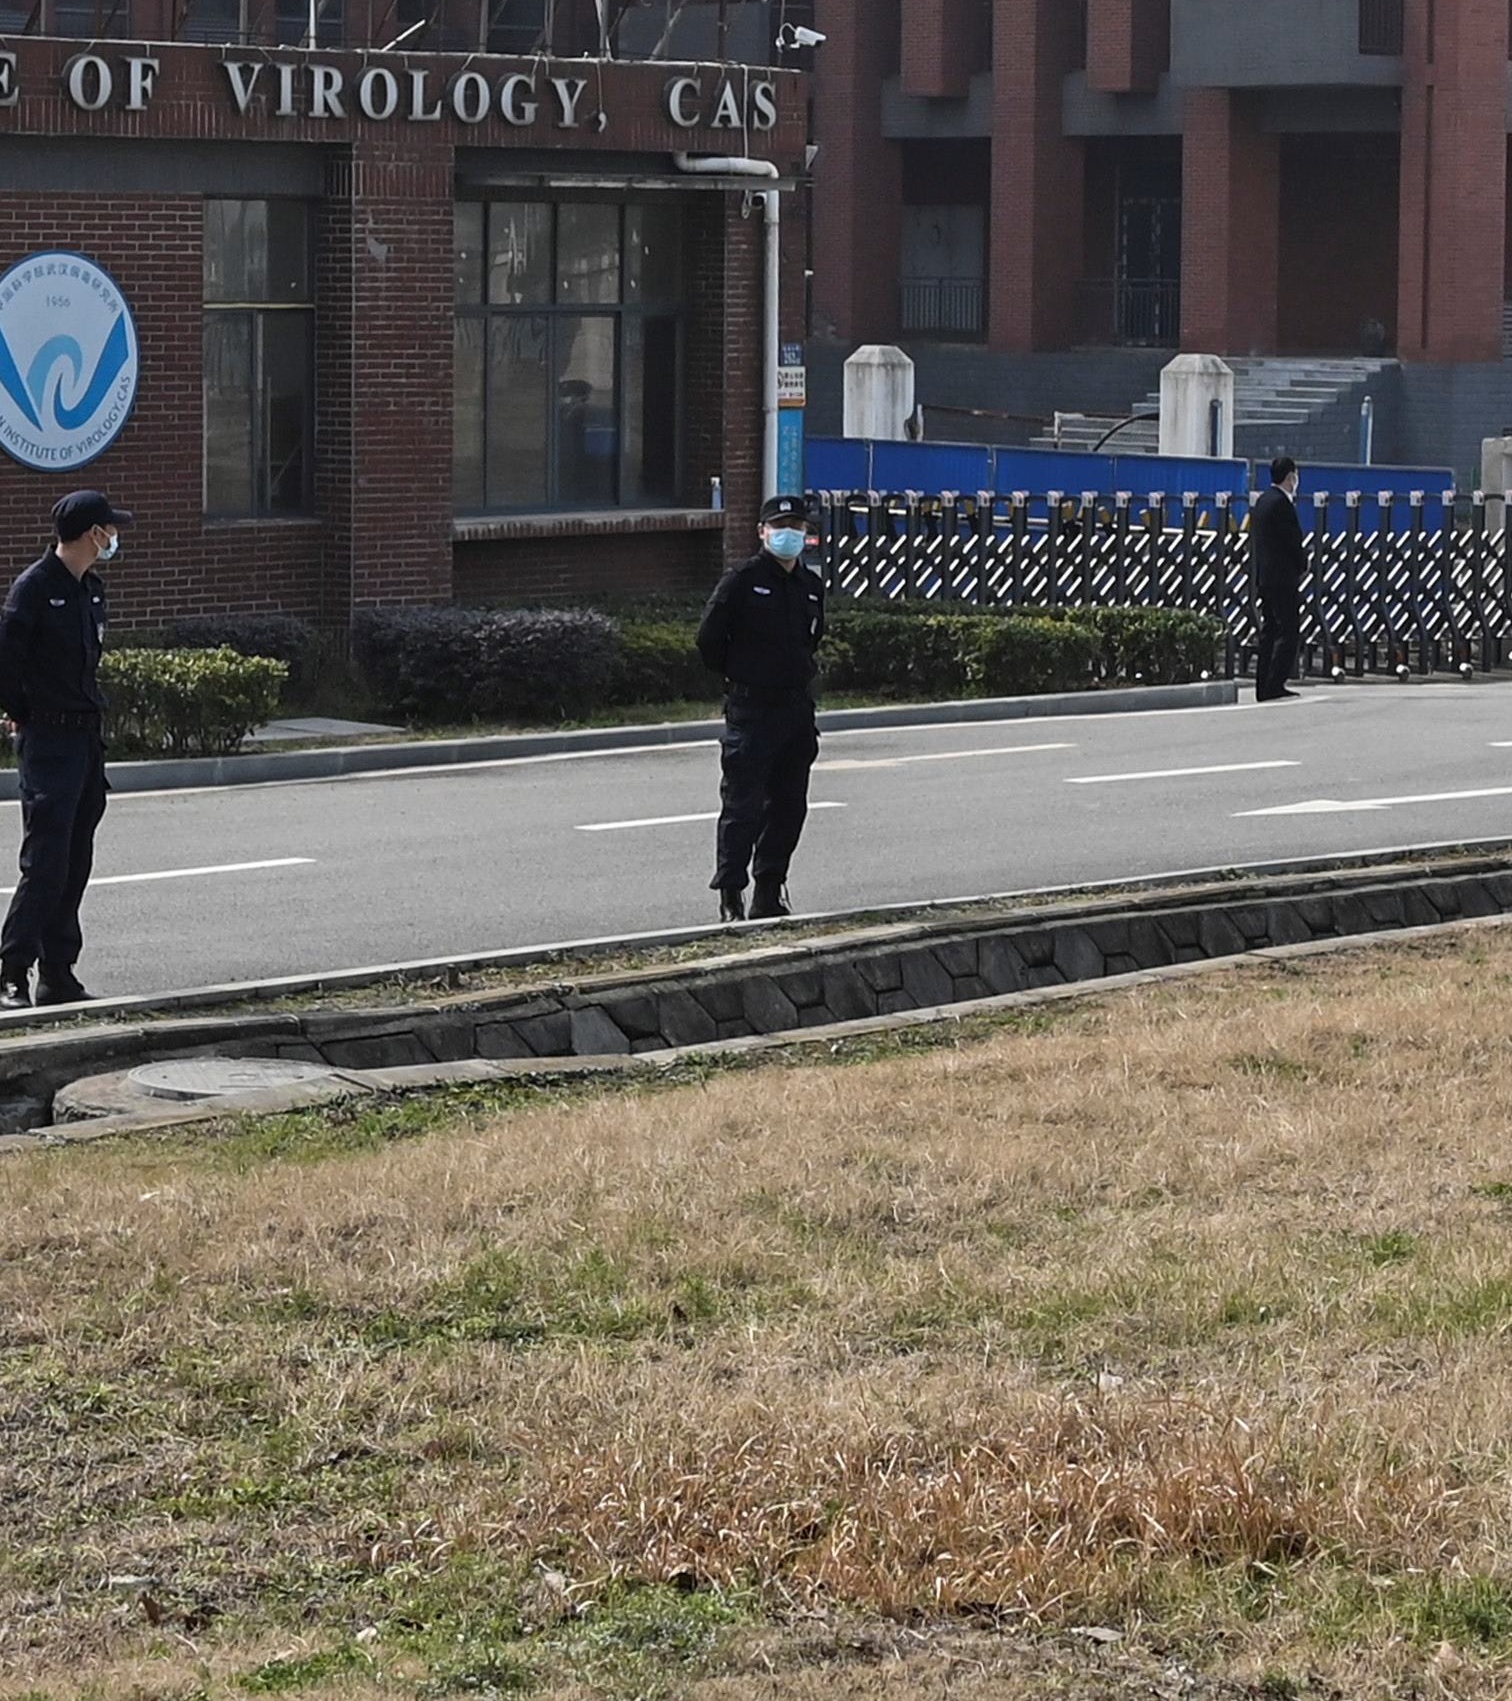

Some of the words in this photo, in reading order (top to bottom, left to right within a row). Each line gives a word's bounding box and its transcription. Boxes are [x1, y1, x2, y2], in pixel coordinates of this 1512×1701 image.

[68, 54, 161, 112] OF
[224, 60, 609, 135] VIROLOGY,
[668, 77, 778, 132] CAS
[3, 424, 57, 461] INSTITUTE
[59, 446, 75, 460] OF
